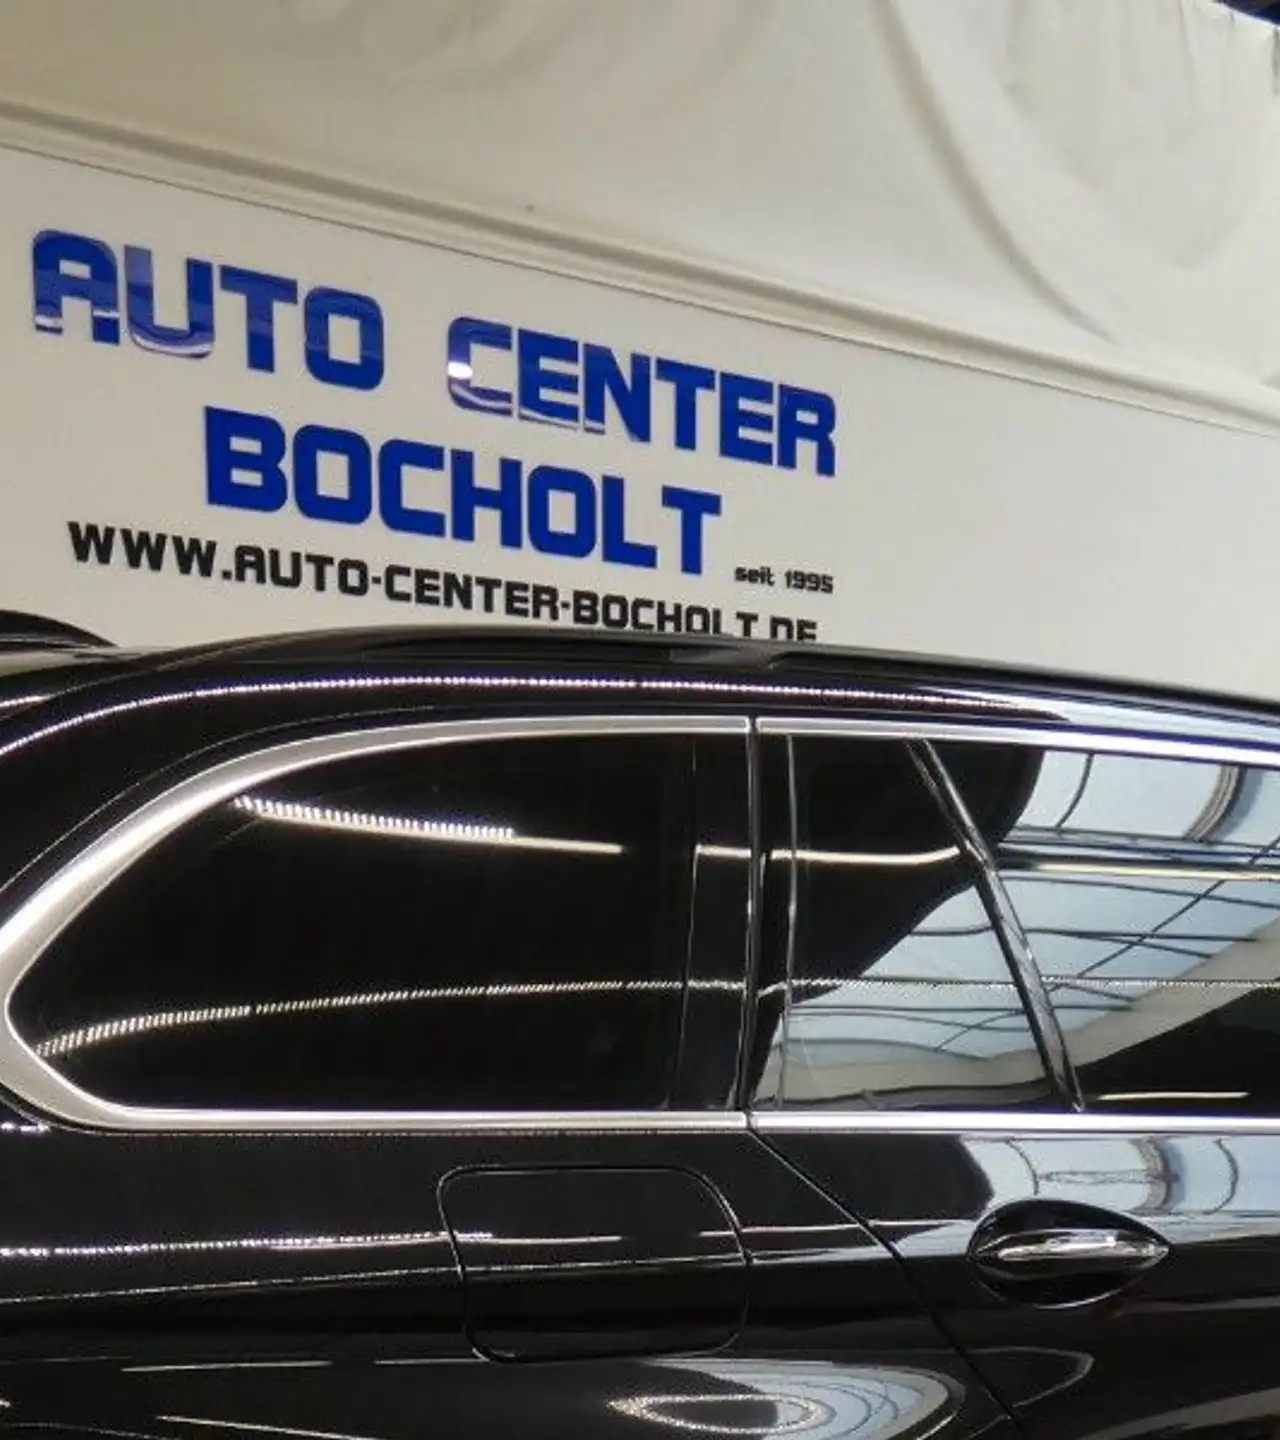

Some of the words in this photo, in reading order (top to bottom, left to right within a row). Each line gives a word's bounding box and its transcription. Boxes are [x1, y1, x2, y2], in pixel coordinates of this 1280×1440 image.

[32, 229, 385, 392] AUTO
[447, 315, 837, 478] CENTER
[204, 406, 723, 577] BOCHOLT
[68, 521, 817, 642] WWW.AUTO-CENTER-BOCHOLTDE
[734, 565, 775, 587] seit
[784, 570, 834, 594] 1995
